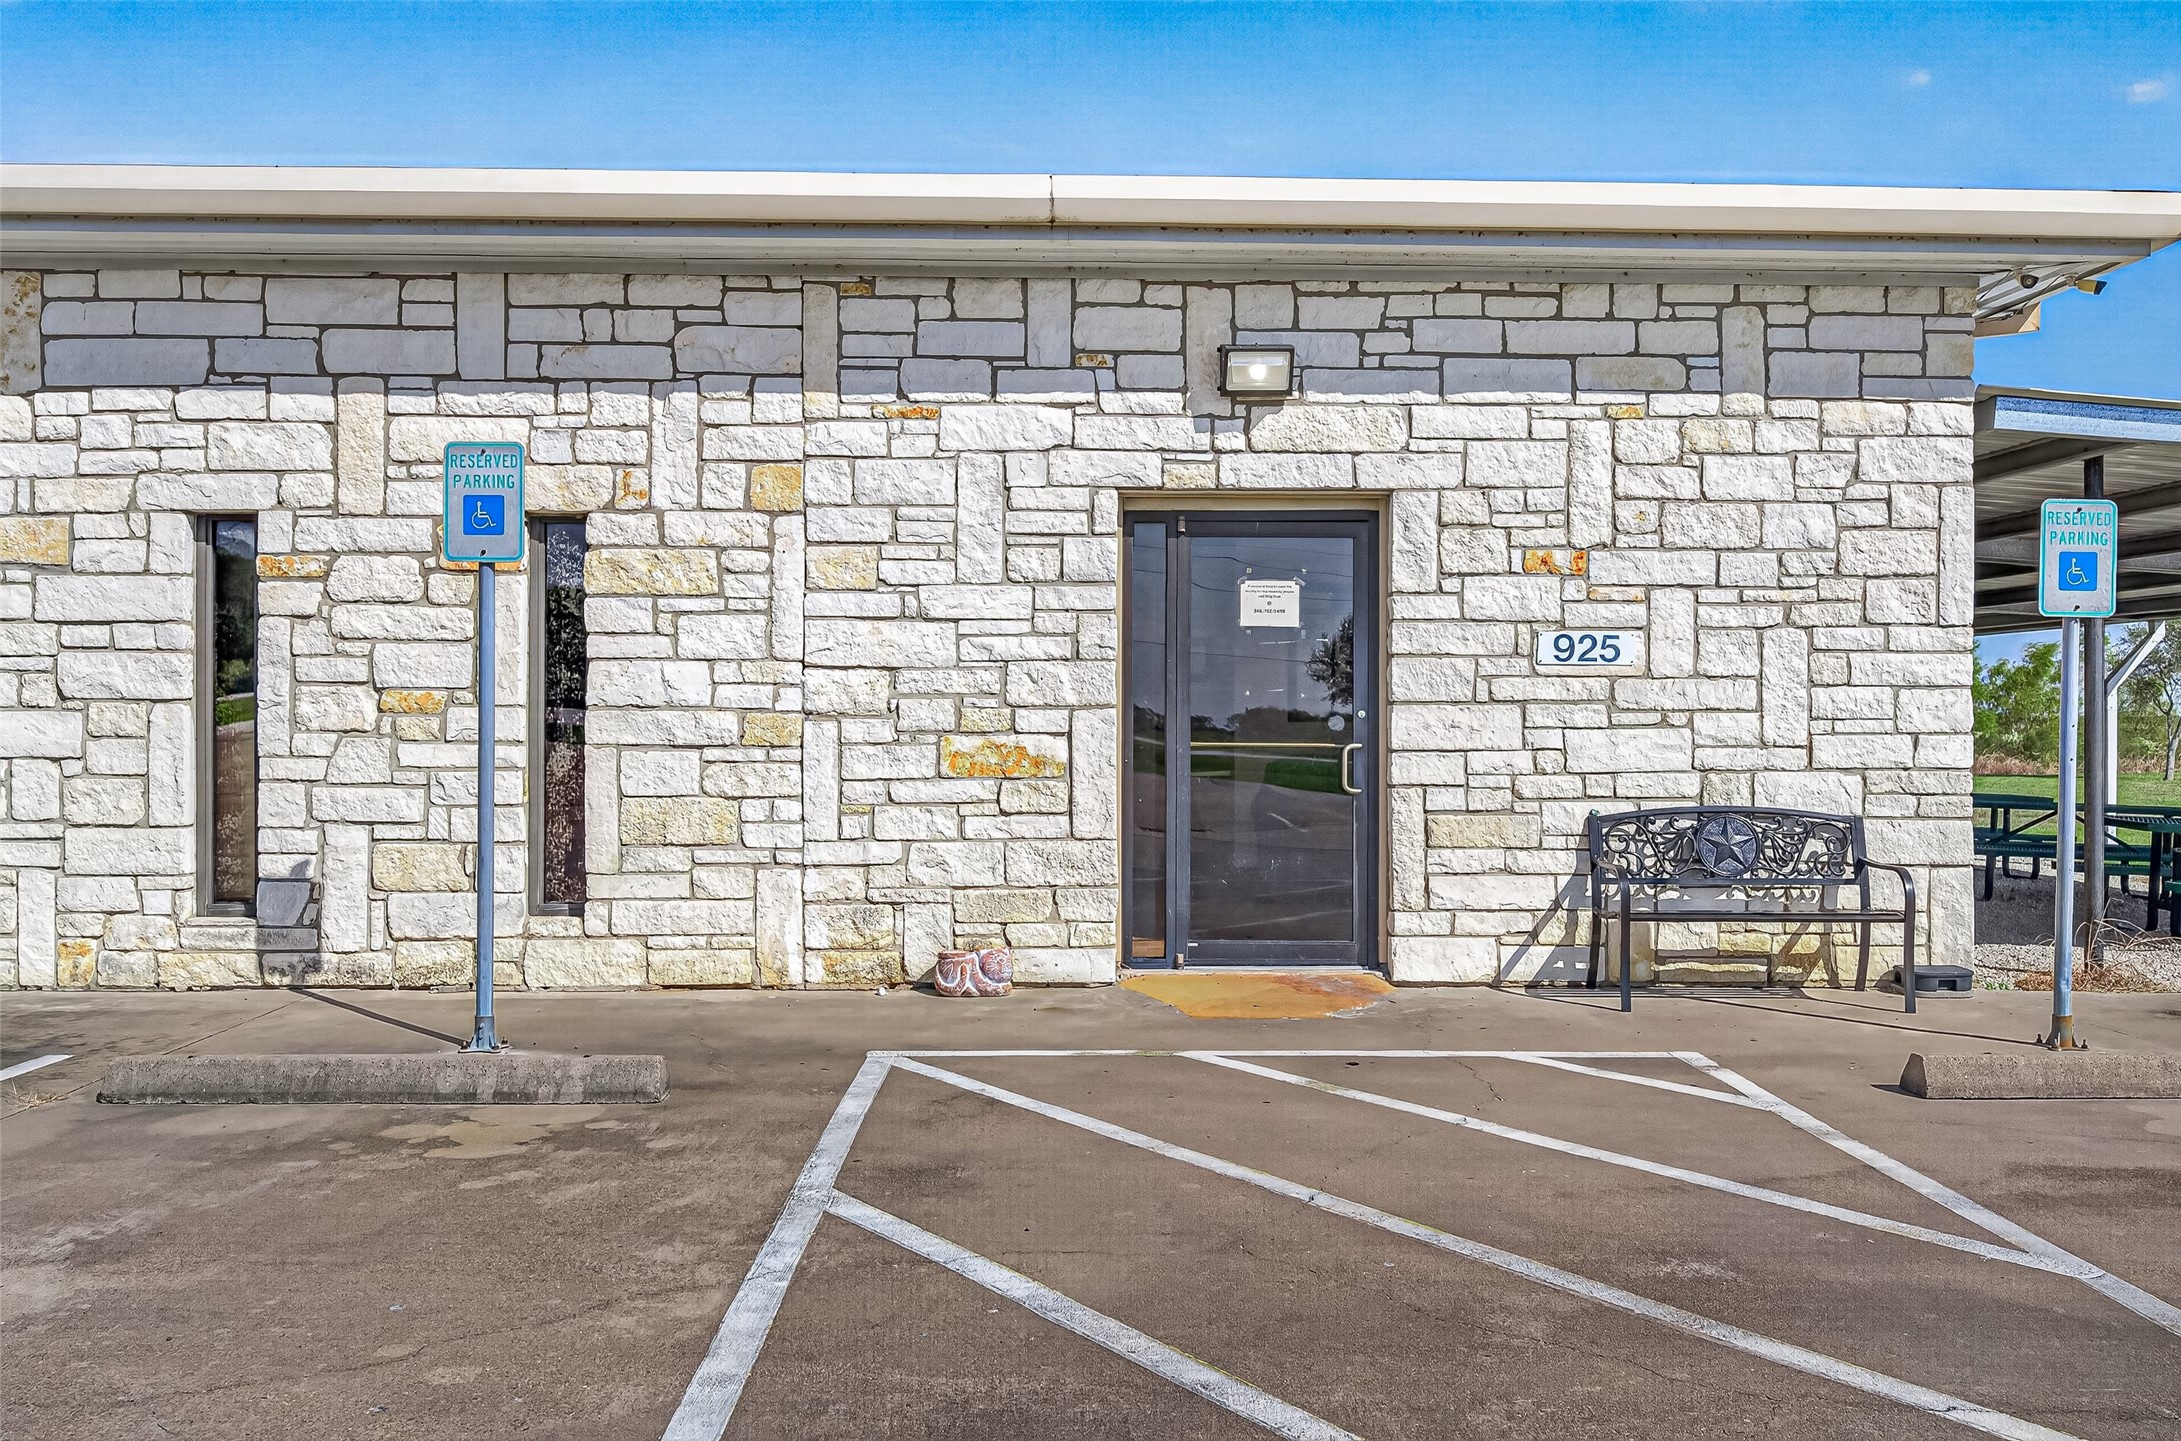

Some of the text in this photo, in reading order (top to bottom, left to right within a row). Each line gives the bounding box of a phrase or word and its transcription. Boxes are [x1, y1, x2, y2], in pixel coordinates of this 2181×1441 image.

[450, 454, 518, 468] RESERVED
[453, 474, 515, 489] PARKING
[2047, 511, 2111, 526] RESERVED
[2049, 530, 2109, 546] PARKING
[1553, 633, 1621, 663] 925
